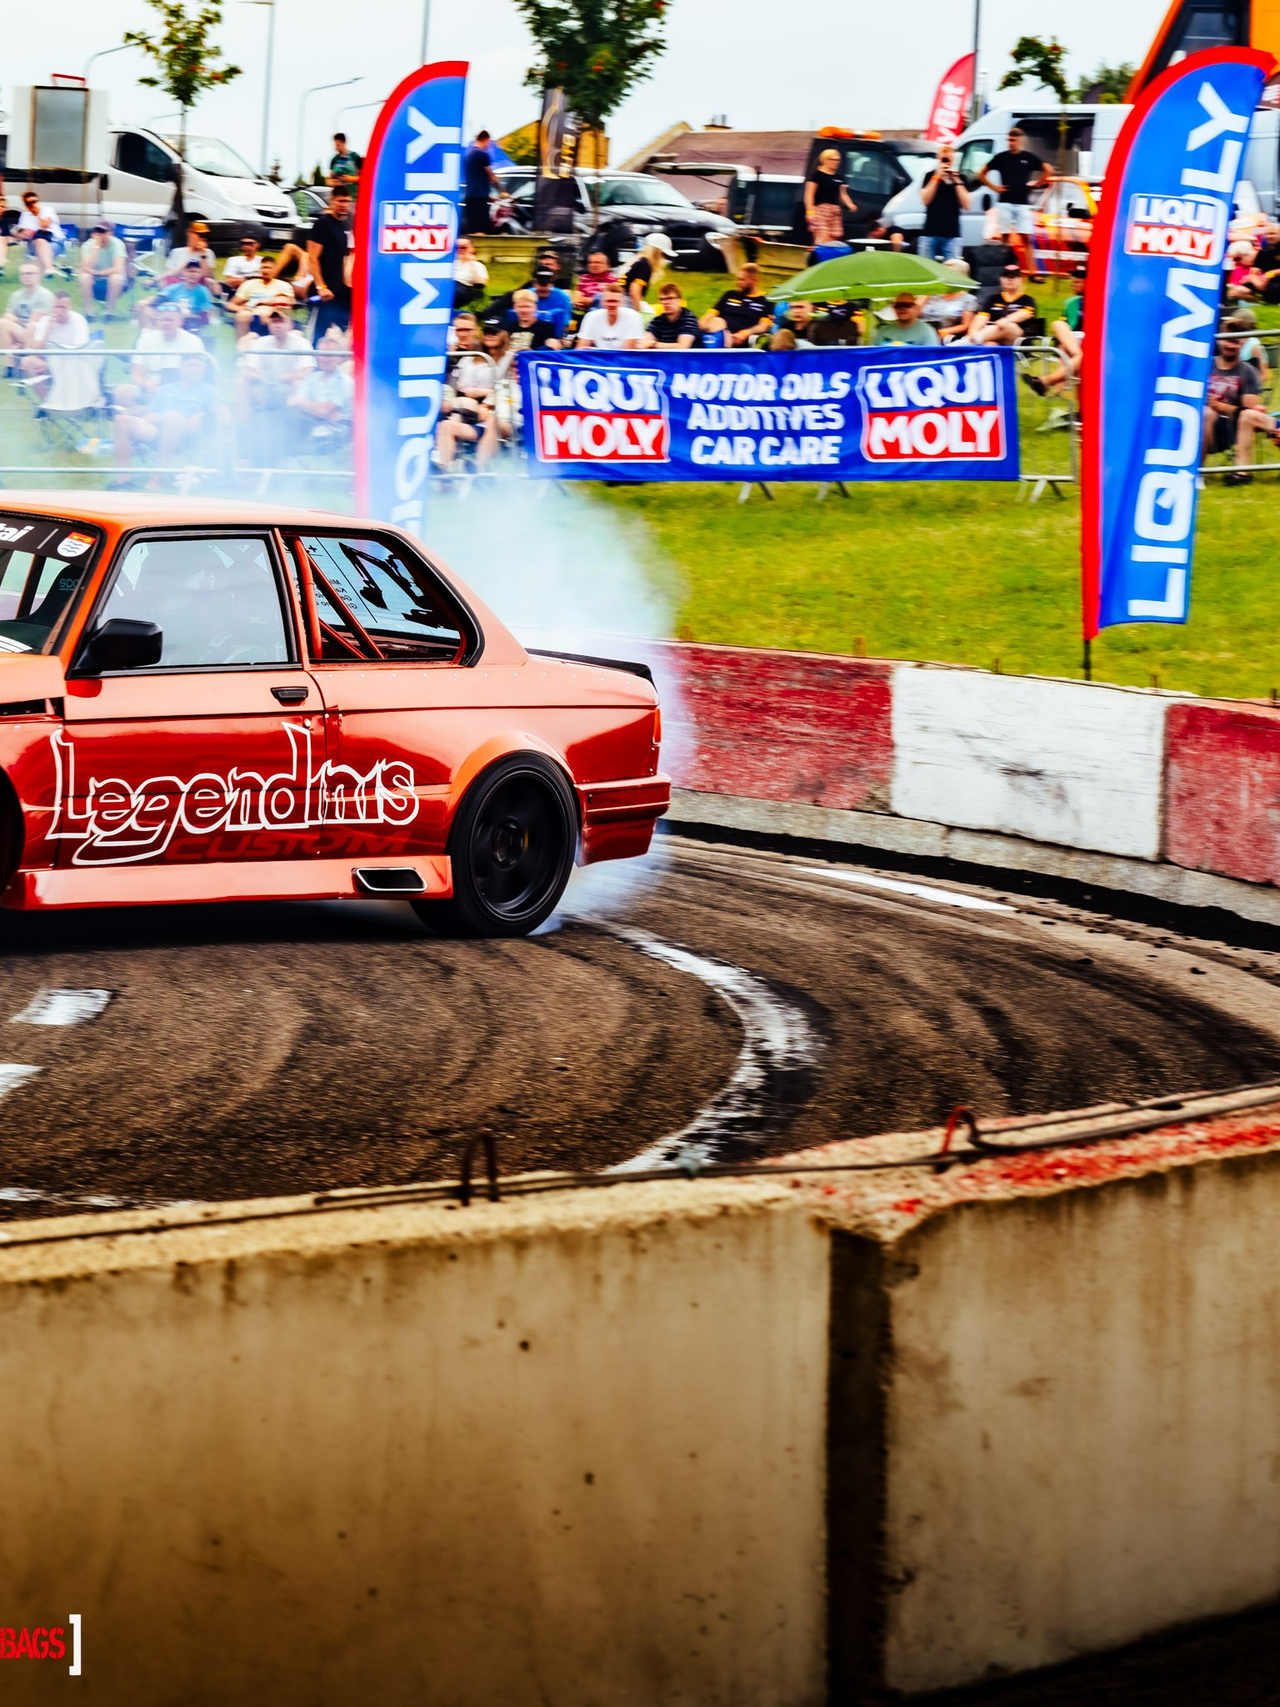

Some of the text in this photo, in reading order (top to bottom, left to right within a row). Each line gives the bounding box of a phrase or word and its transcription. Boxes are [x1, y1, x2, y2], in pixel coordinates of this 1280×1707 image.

[383, 203, 451, 227] LIQUI
[1133, 197, 1215, 230] LIQUI
[382, 228, 451, 251] MOLY
[1131, 226, 1216, 257] MOLY
[536, 366, 662, 412] LIQUI
[671, 371, 852, 401] MOTOR OILS
[864, 360, 995, 408] LIQUI
[686, 403, 845, 430] ADDITIVES
[540, 414, 665, 456] MOLY
[869, 410, 1000, 455] MOLY
[690, 436, 843, 465] CAR CARE
[1127, 377, 1204, 618] LIQUI
[165, 829, 412, 860] CUSTOM
